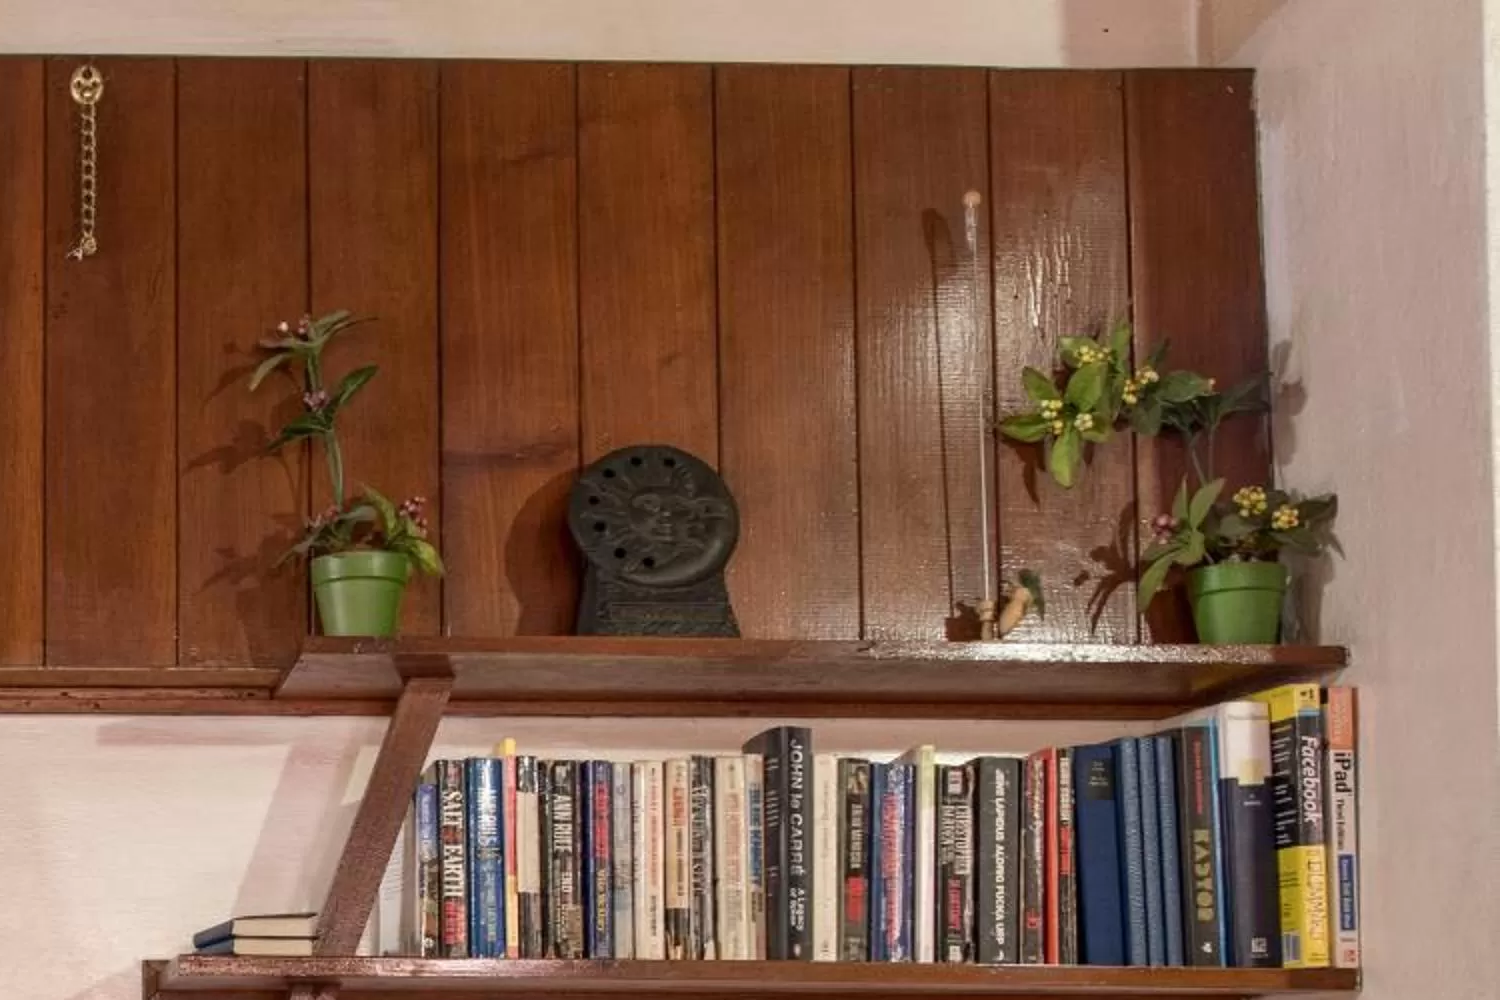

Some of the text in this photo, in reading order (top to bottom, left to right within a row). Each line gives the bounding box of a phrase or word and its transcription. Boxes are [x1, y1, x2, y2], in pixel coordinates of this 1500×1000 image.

[790, 739, 808, 876] JOHN le CARRÉ
[1301, 736, 1323, 824] Facebook
[1334, 752, 1352, 794] iPad
[443, 791, 464, 898] SALT EARTH
[553, 794, 573, 854] ANN RULE
[993, 769, 1006, 944] JENS LAPIDUS ALDRIG FUCKA UPP
[561, 872, 573, 893] END
[794, 897, 806, 932] Legacy
